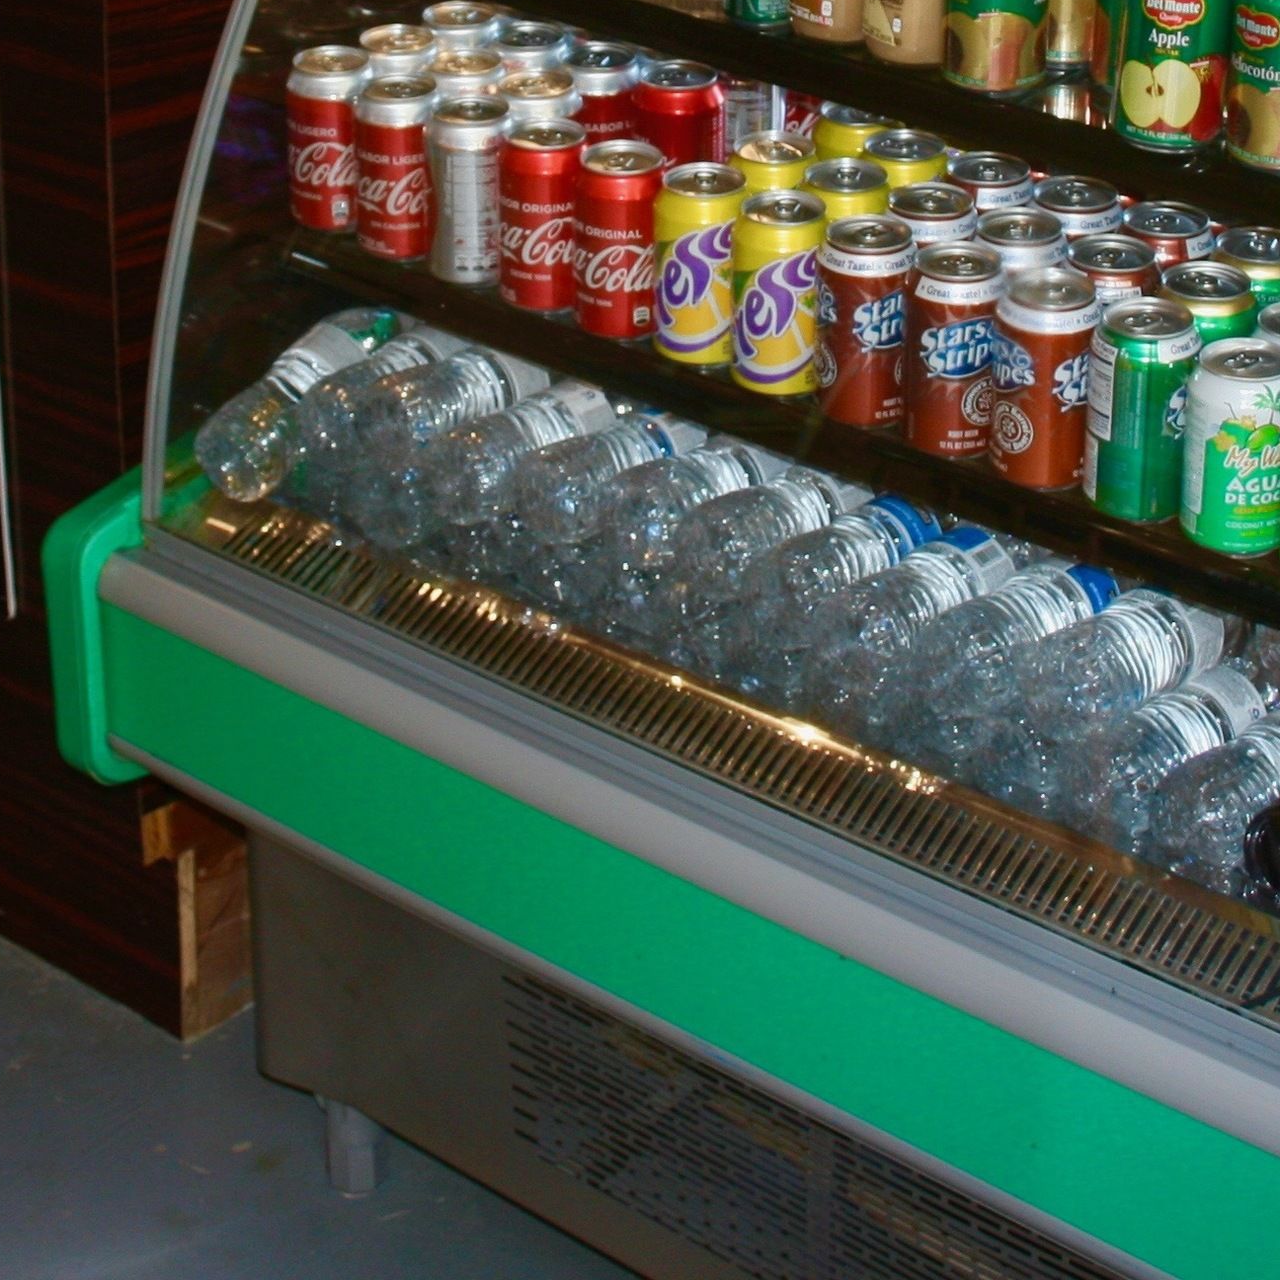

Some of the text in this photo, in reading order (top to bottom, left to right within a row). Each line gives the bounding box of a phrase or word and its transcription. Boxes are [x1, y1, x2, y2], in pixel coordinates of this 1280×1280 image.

[1247, 17, 1278, 37] Monte
[1148, 28, 1191, 49] Apple
[585, 225, 643, 240] ORIGINAL
[1224, 493, 1247, 506] DE
